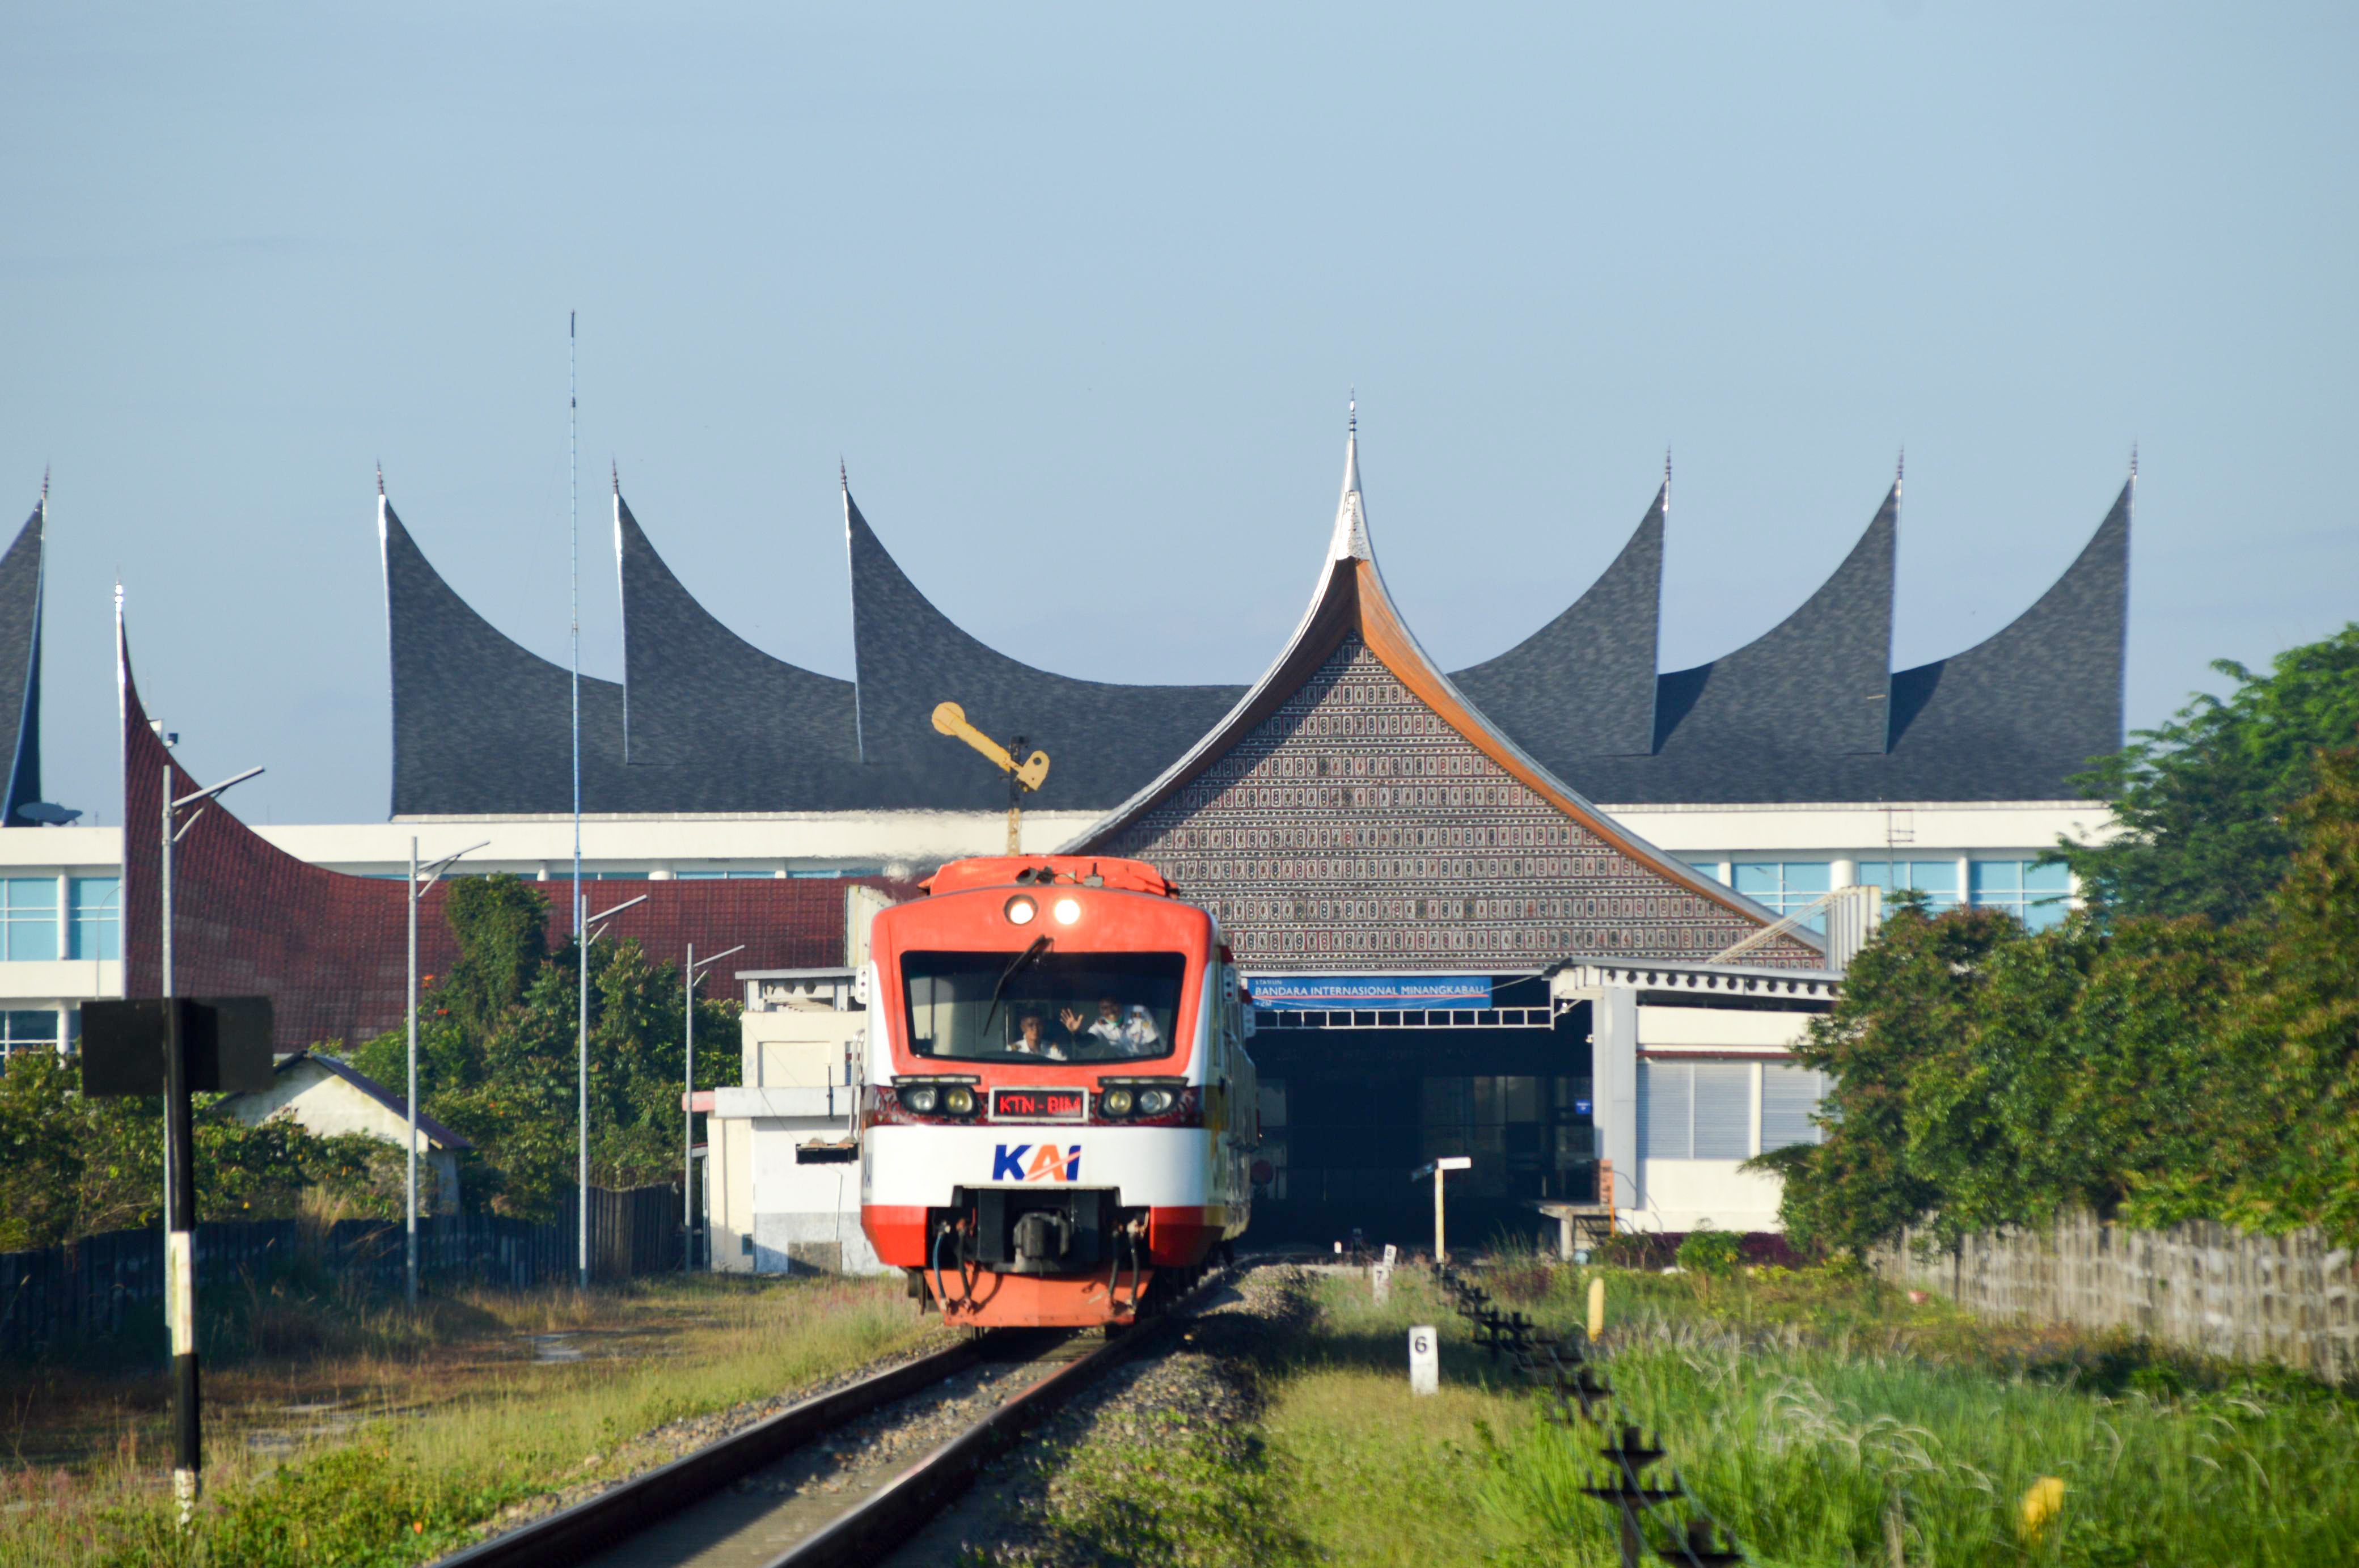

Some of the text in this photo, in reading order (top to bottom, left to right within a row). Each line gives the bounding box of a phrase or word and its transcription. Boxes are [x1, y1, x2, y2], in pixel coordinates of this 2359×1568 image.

[1255, 986, 1484, 996] BANDARA INTERNASIONAL MINANGKABAU
[999, 1096, 1034, 1114] KTN
[1047, 1096, 1080, 1114] BIM
[992, 1144, 1081, 1181] KAI
[1376, 1270, 1382, 1280] 7
[1415, 1336, 1427, 1353] 6
